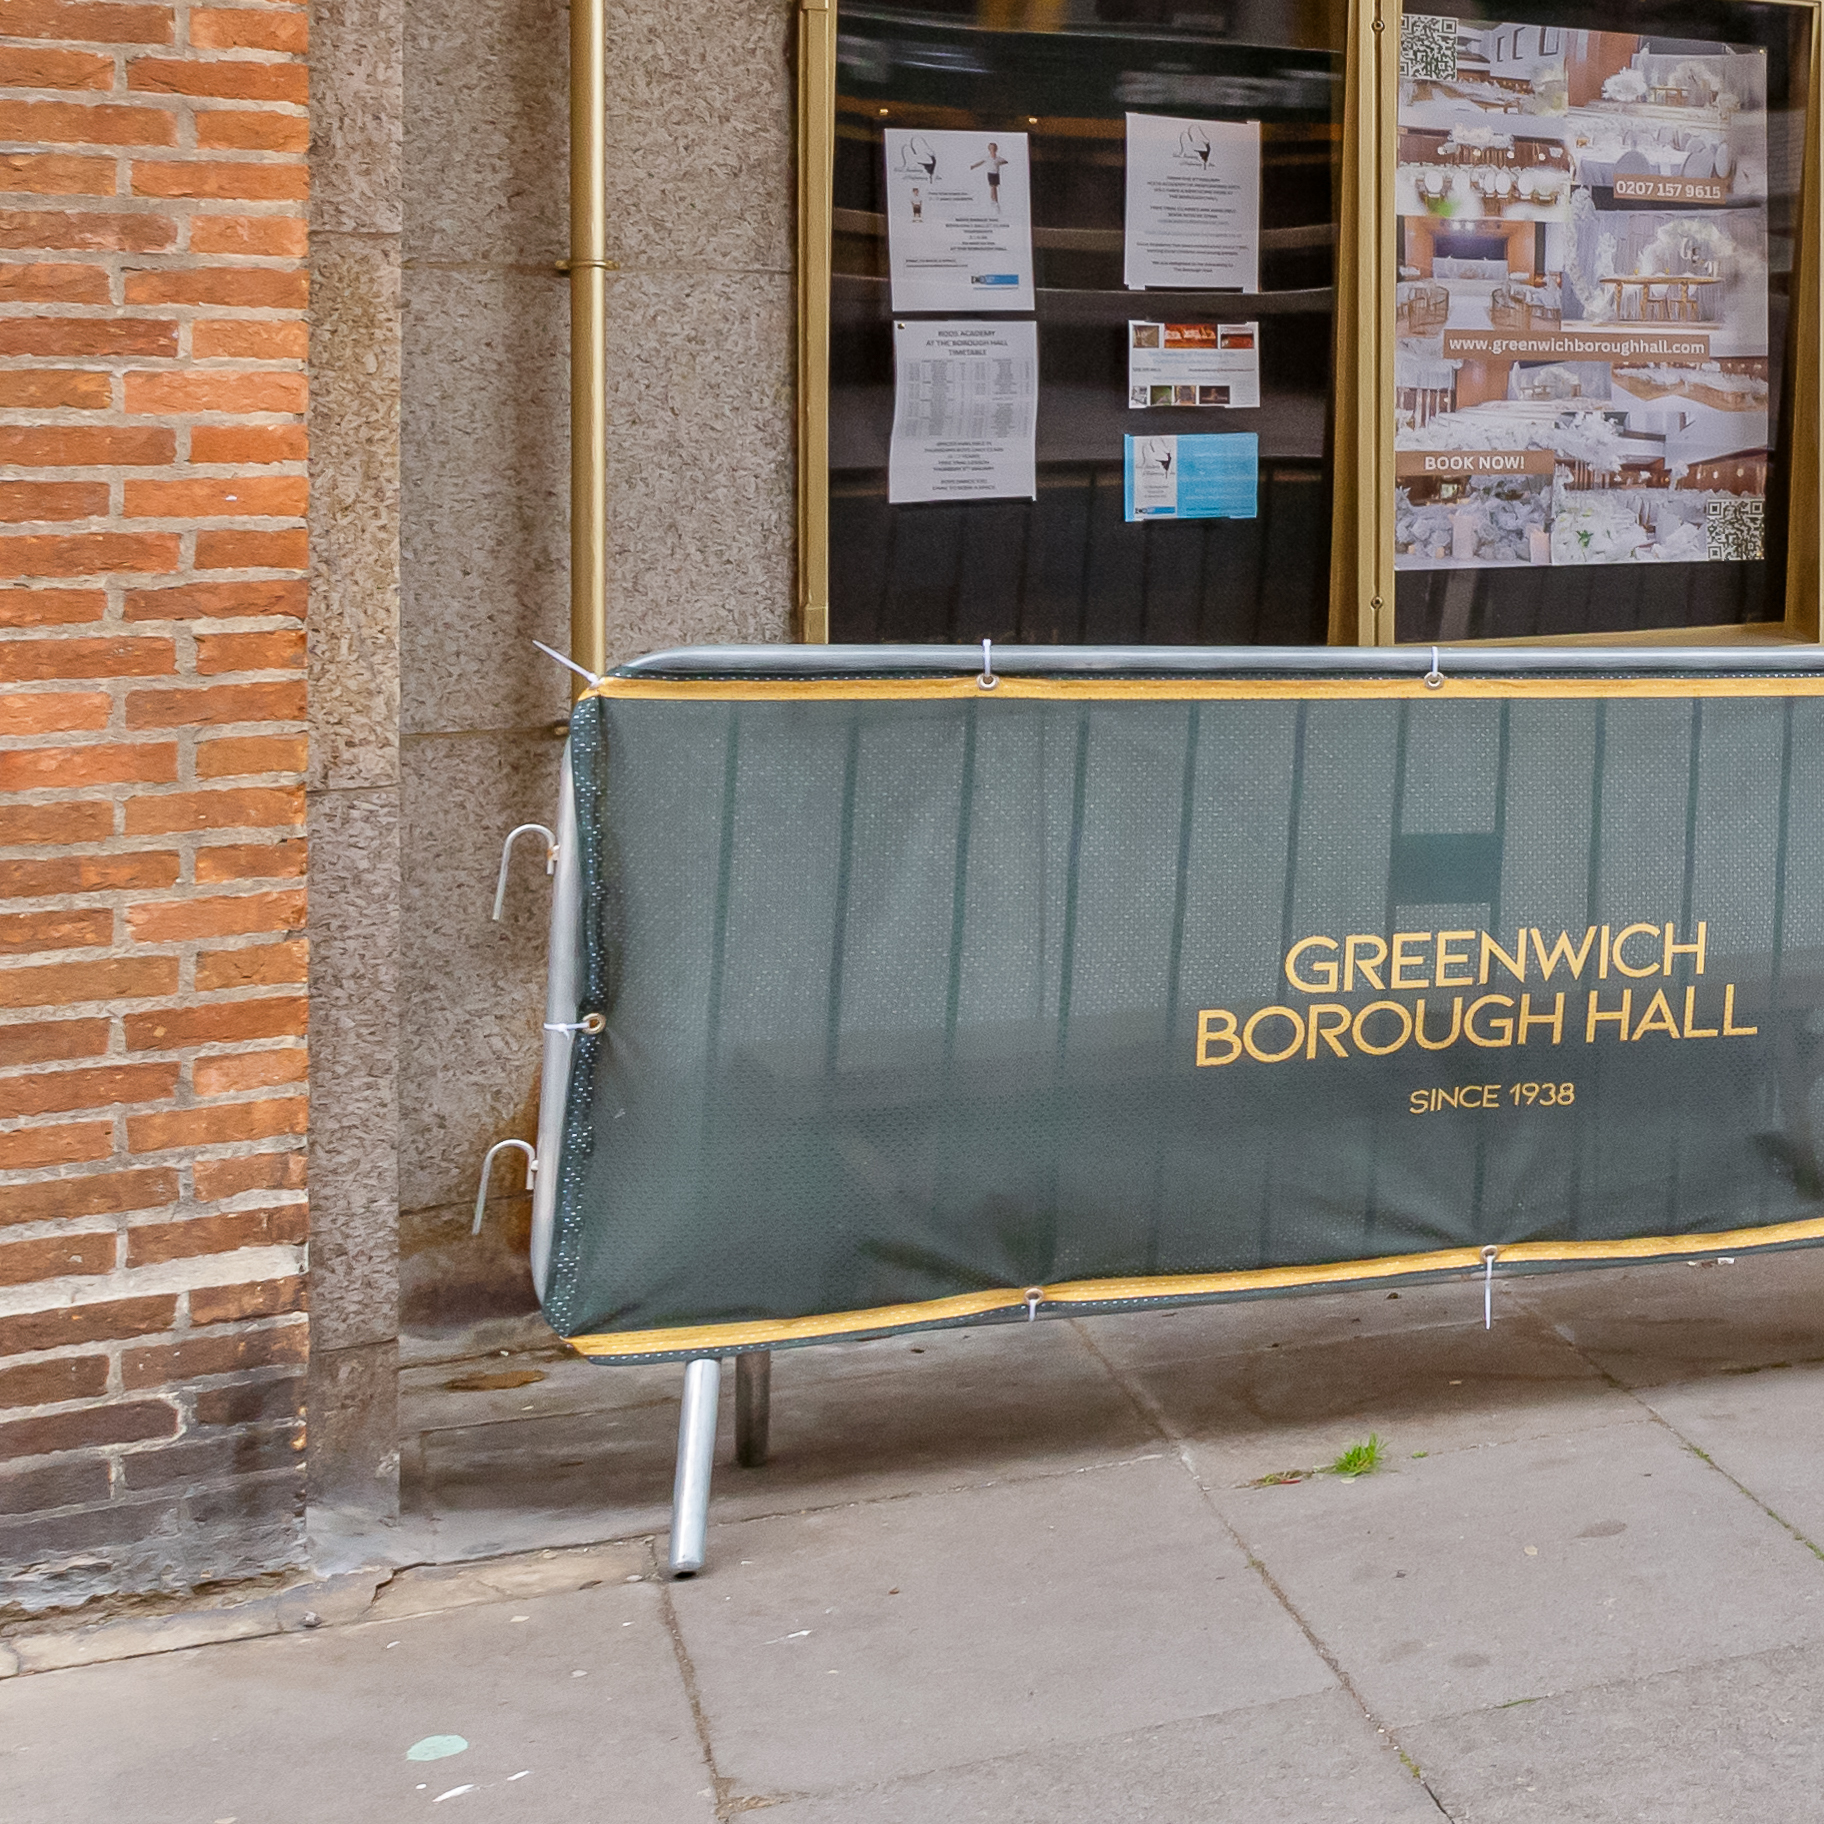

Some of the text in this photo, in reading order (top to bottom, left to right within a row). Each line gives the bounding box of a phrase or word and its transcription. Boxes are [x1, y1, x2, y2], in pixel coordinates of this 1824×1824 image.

[1616, 180, 1720, 198] 0207 157 9615
[1449, 338, 1705, 356] www.greenwichboroughhall.com
[1425, 455, 1525, 470] BOOK NOW!
[1285, 921, 1707, 994] GREENWICH
[1196, 984, 1758, 1067] BOROUGH HALL
[1409, 1082, 1575, 1114] SINCE 1938
